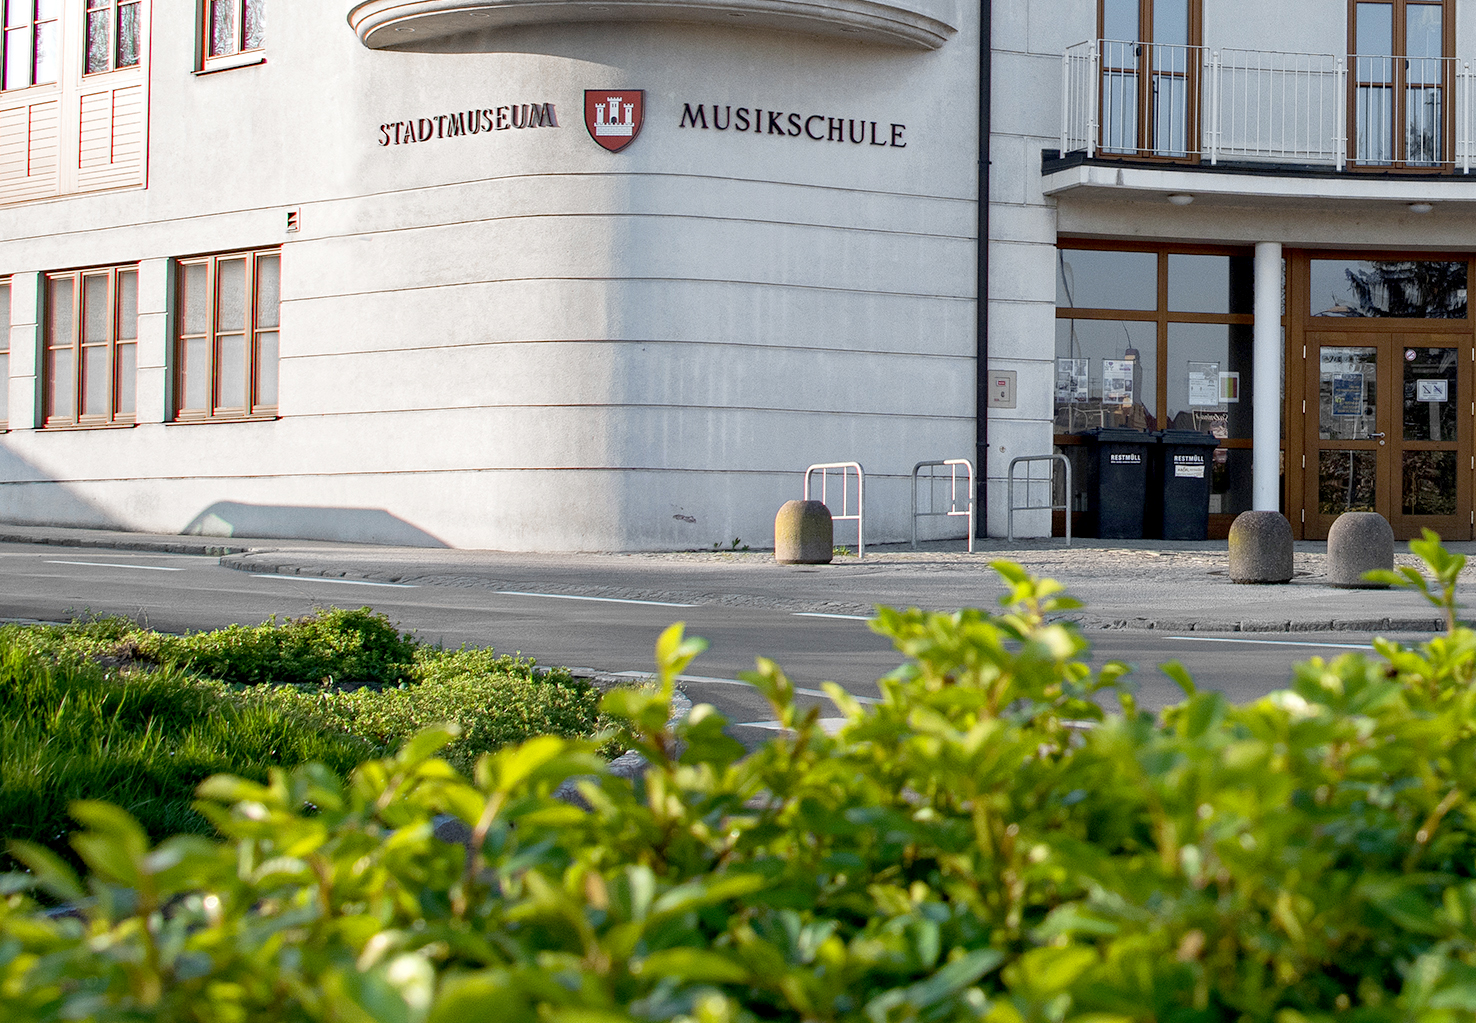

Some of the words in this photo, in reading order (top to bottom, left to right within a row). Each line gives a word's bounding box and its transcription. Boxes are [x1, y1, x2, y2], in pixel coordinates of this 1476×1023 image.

[378, 102, 560, 147] STADTMUSEUM
[679, 103, 907, 148] MUSIKSCHULE
[1110, 453, 1141, 461] RESTMÜLL
[1173, 454, 1204, 462] RESTMÜLL
